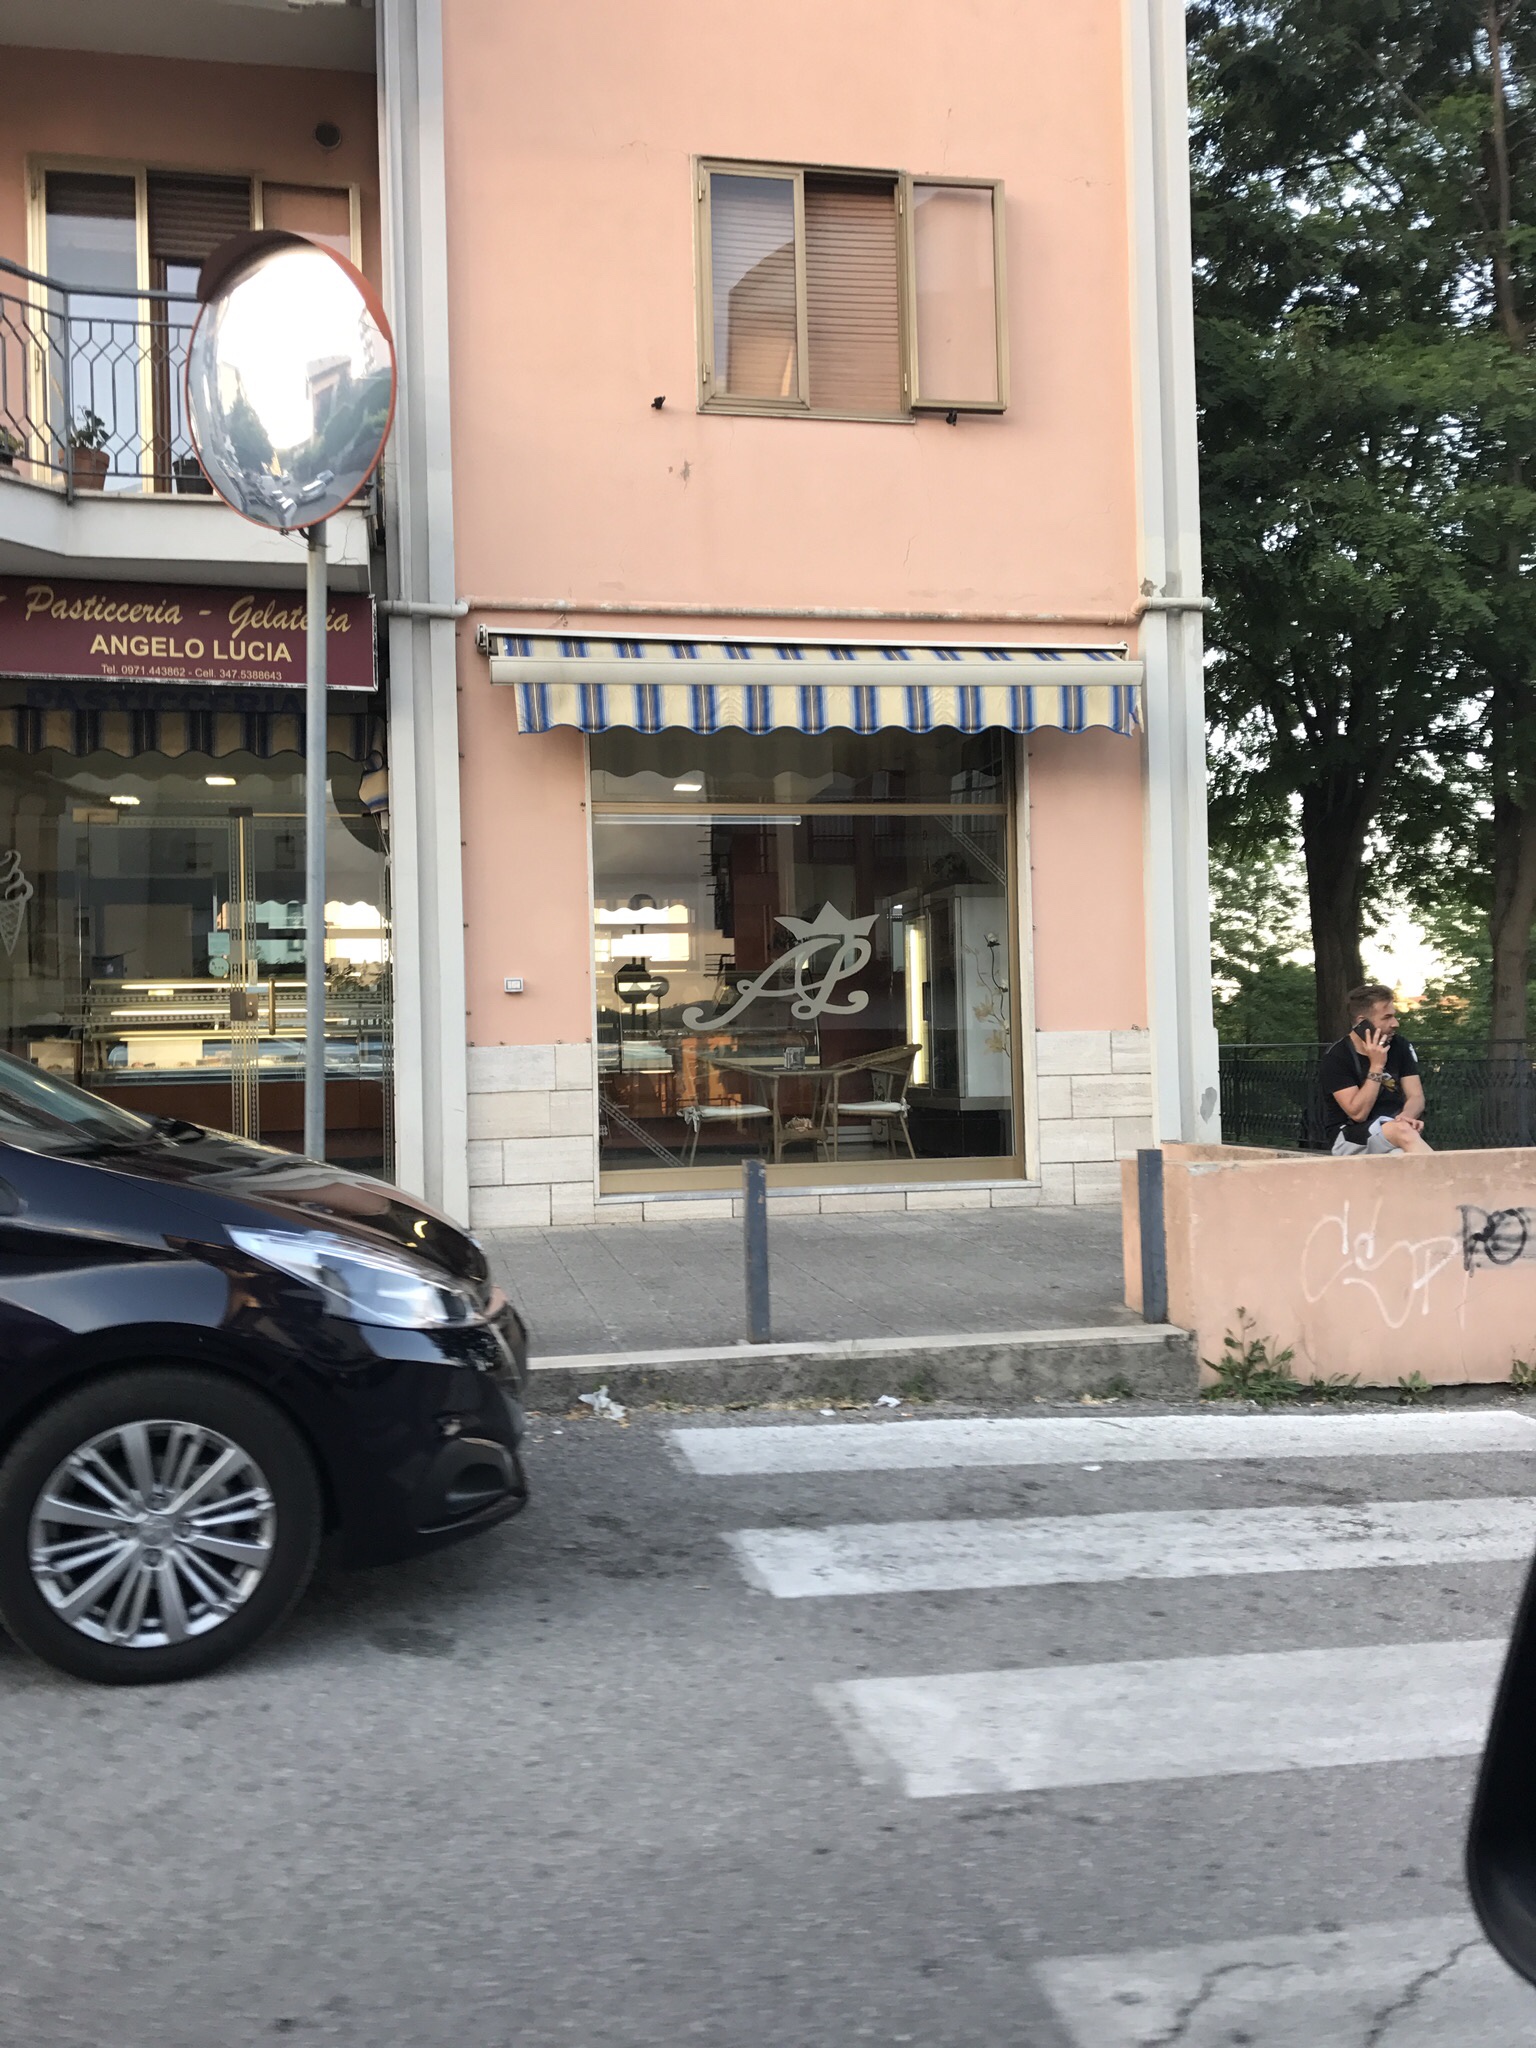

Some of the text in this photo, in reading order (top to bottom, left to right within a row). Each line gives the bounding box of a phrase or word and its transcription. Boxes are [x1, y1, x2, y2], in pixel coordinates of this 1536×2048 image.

[25, 584, 183, 625] Pasticceria
[228, 595, 351, 639] Gelateia
[90, 634, 292, 662] ANGELO LUCIA
[101, 663, 119, 675] Tel.
[121, 665, 186, 677] 0971.443862
[195, 668, 217, 679] Cell.
[219, 669, 282, 681] 347.5388643
